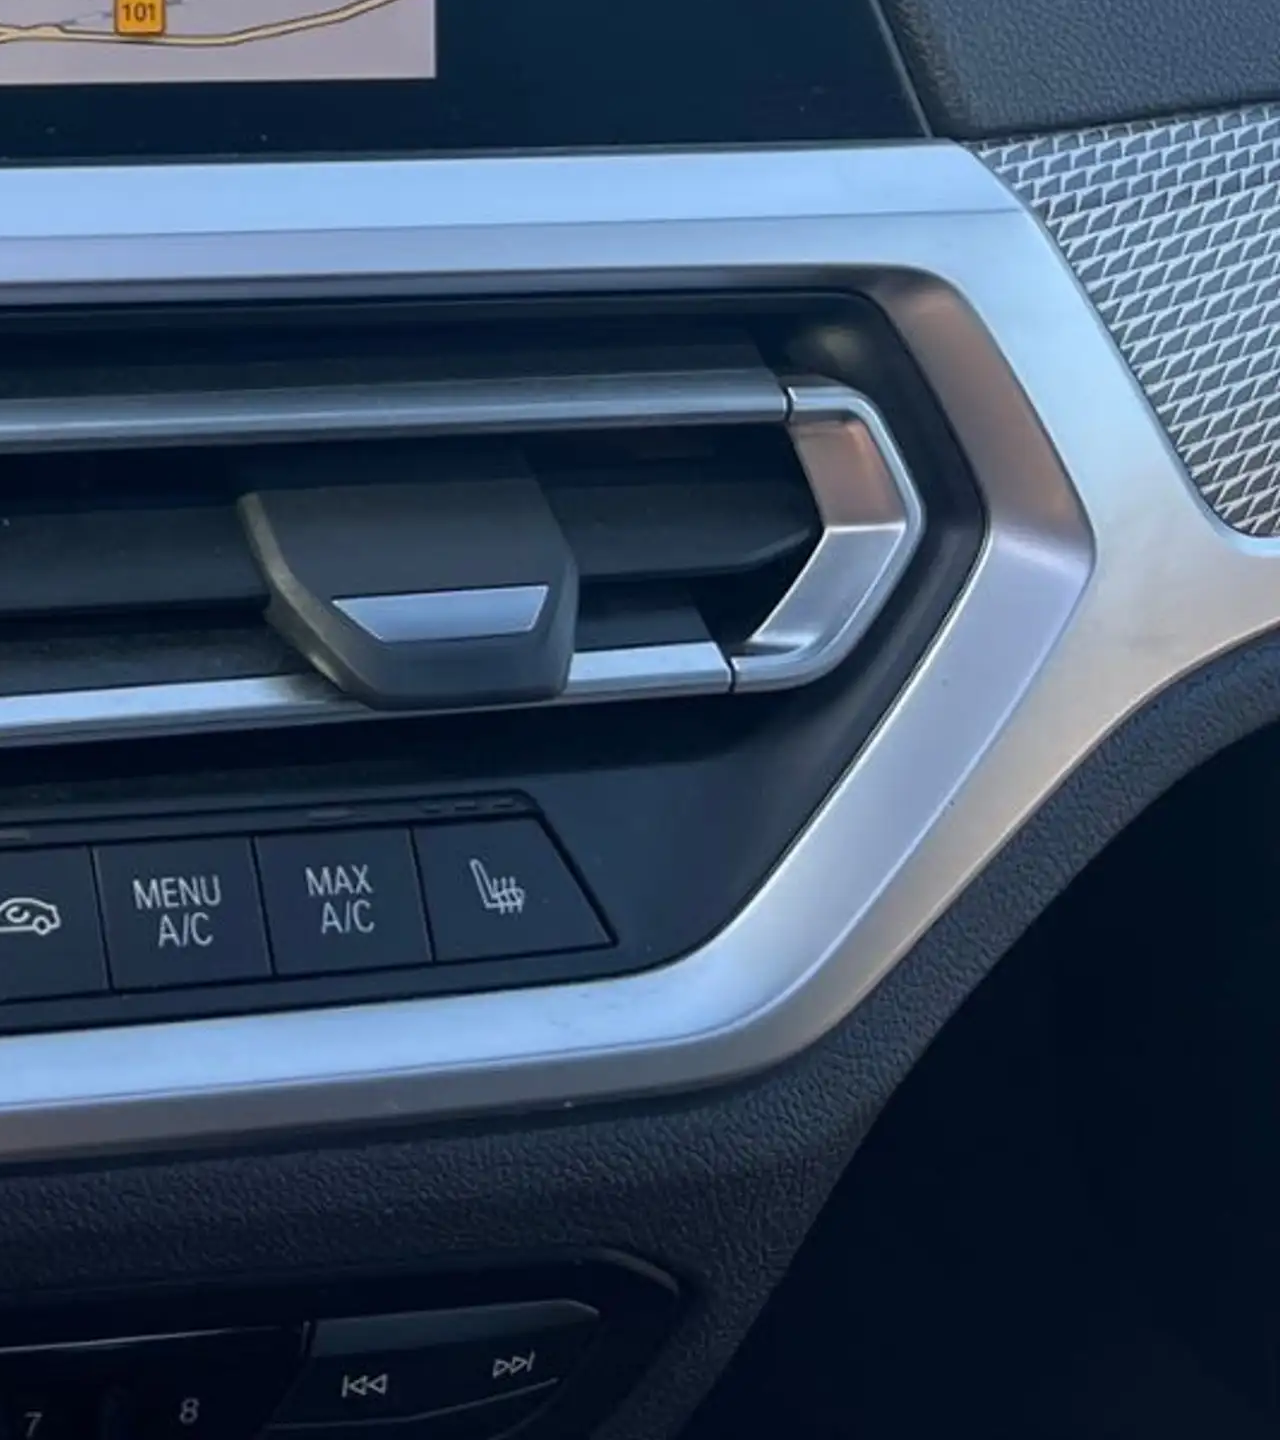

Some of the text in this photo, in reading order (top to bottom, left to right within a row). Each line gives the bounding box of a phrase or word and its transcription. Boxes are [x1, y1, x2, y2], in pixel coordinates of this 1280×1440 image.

[121, 3, 158, 23] 101
[132, 875, 223, 910] MENU
[305, 864, 374, 898] MAX
[157, 912, 214, 948] A/C
[319, 900, 375, 934] A/C
[23, 1411, 44, 1439] 7
[179, 1397, 200, 1425] 8
